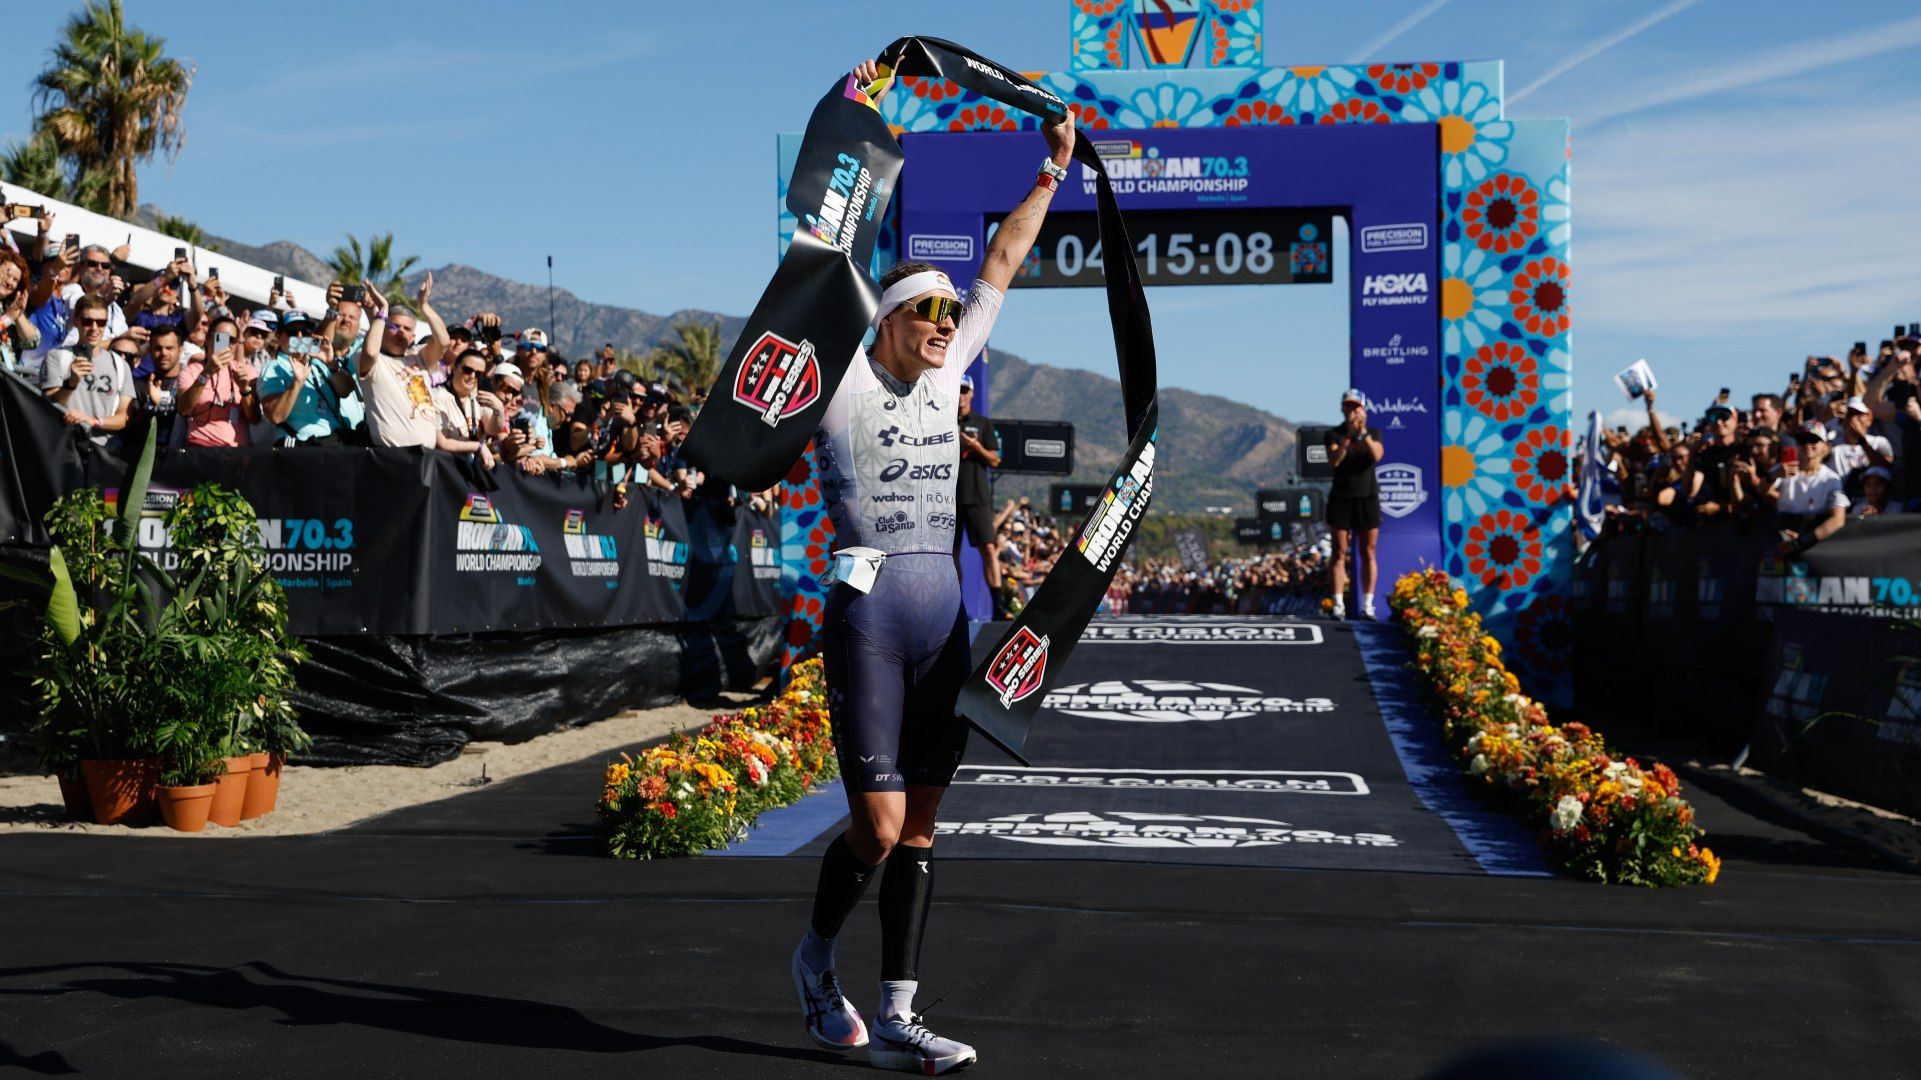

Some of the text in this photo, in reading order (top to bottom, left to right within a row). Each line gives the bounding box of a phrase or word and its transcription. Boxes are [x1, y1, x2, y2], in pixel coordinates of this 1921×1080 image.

[963, 56, 1004, 80] WORLD
[829, 152, 860, 200] 70.3
[1202, 156, 1248, 178] 70.3
[1083, 178, 1249, 195] WRLD CHAMPIONSHIP
[914, 240, 969, 250] PRECISION
[1366, 229, 1423, 241] PRECISION
[1056, 232, 1274, 277] 0415:08
[1362, 272, 1429, 296] HOKA
[1362, 345, 1430, 358] BREITLING
[781, 343, 813, 395] SERIES
[899, 431, 955, 447] CUBE
[871, 492, 915, 502] wahoo
[878, 516, 895, 524] Club
[285, 517, 354, 550] 70.3
[1096, 519, 1133, 573] WORLD
[456, 554, 484, 572] WORLD
[279, 577, 353, 591] Marbella Spain
[1872, 576, 1921, 606] 70.
[1002, 639, 1048, 704] PRO SERIES
[875, 773, 891, 782] DT
